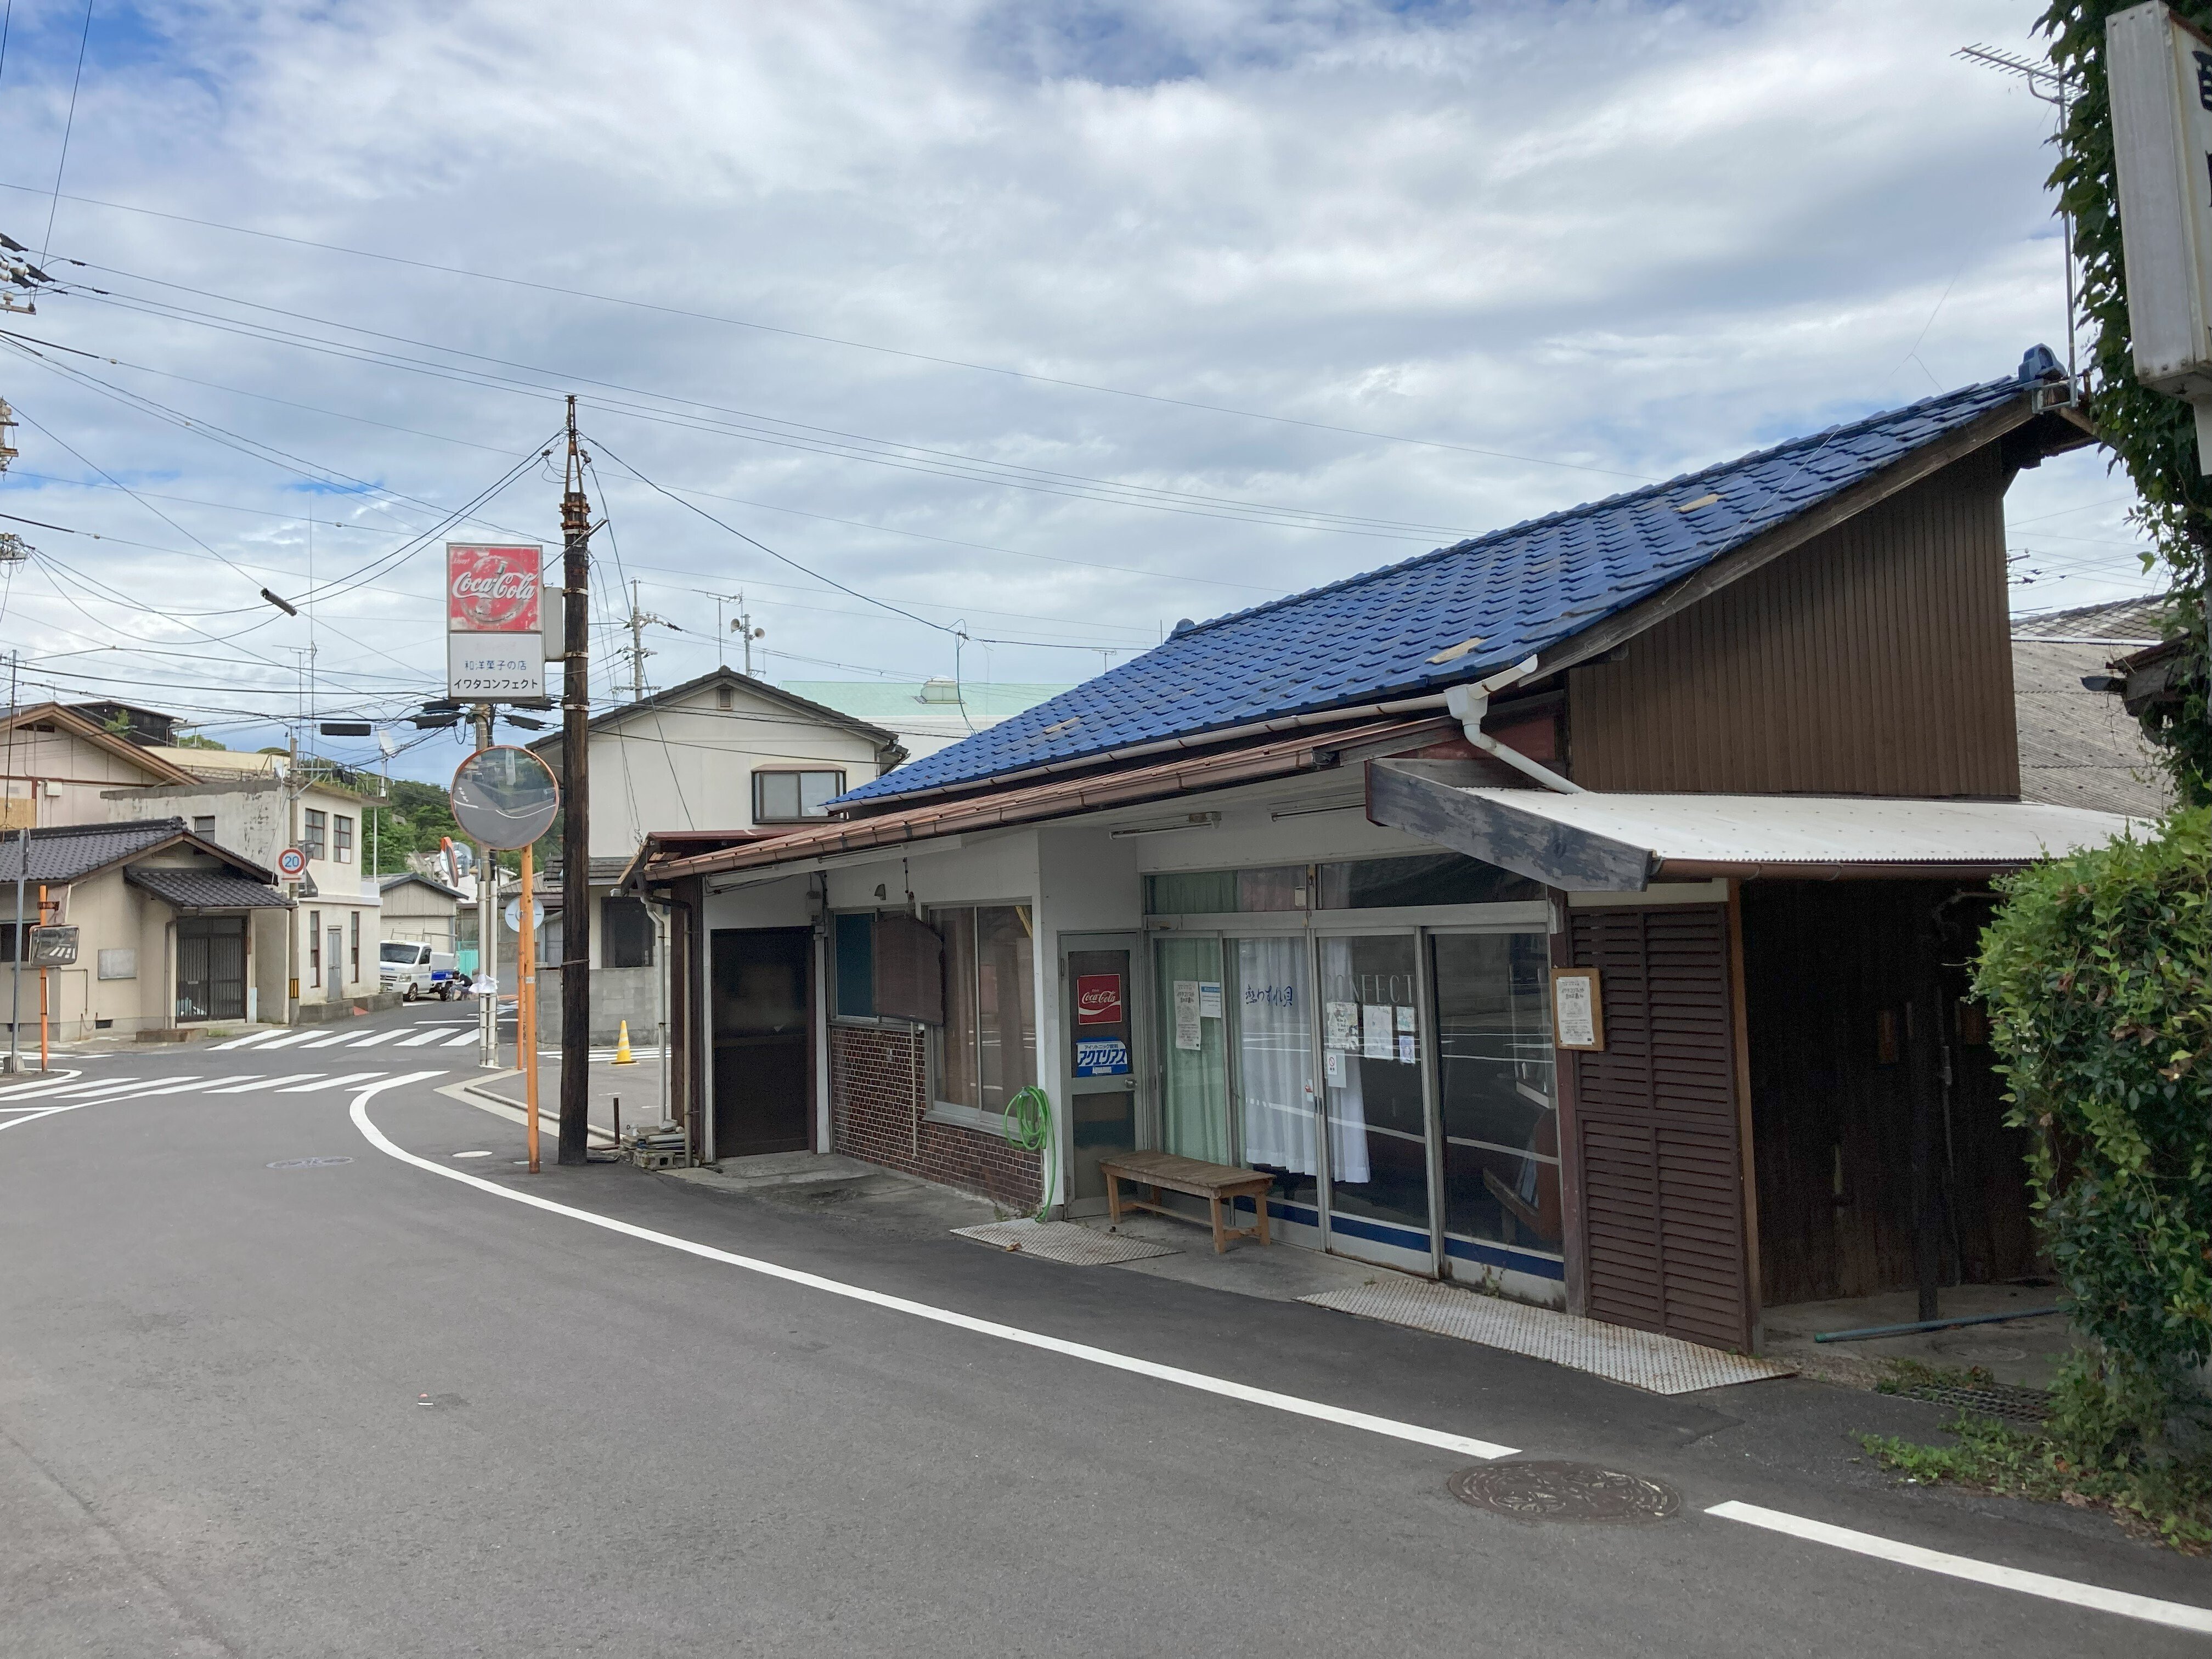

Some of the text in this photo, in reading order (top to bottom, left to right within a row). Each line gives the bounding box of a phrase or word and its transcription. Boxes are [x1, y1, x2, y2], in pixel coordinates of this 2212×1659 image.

[465, 660, 527, 671] 和洋菓子の店
[454, 679, 538, 689] イワタコンフェクト
[285, 856, 300, 867] 20
[1078, 1048, 1126, 1066] アクエリアス
